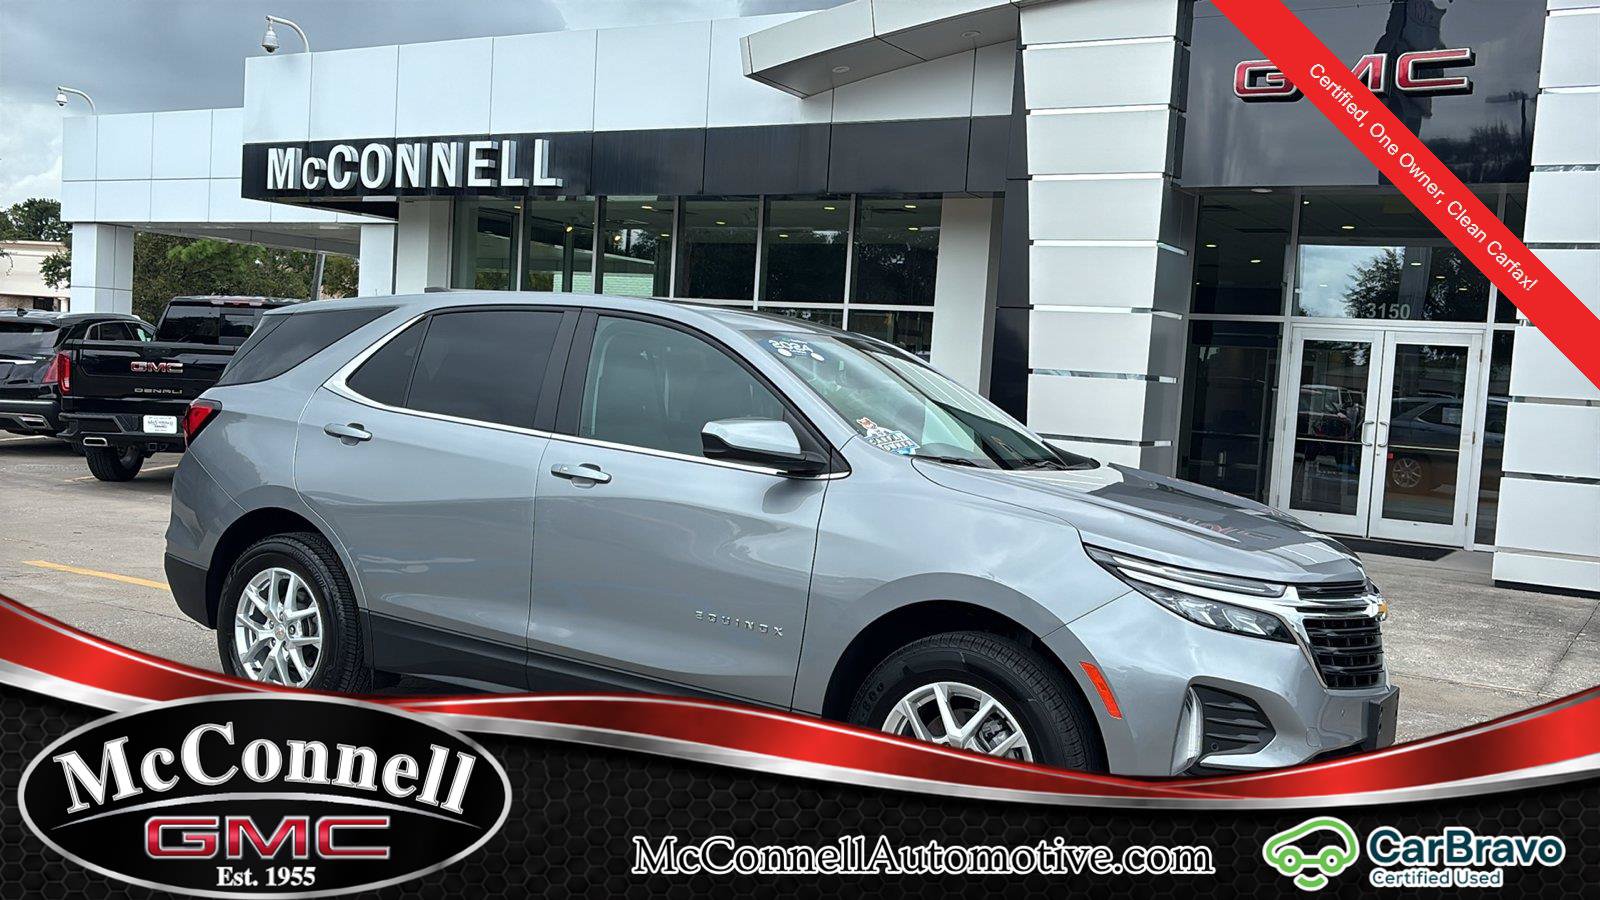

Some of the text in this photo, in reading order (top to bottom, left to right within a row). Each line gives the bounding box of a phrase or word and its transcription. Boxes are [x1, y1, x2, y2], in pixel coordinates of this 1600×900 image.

[267, 138, 563, 191] McCONNELL
[1366, 302, 1411, 319] 3150
[130, 361, 184, 374] GMC
[134, 387, 183, 395] DENALI
[695, 610, 784, 638] EQUINOX
